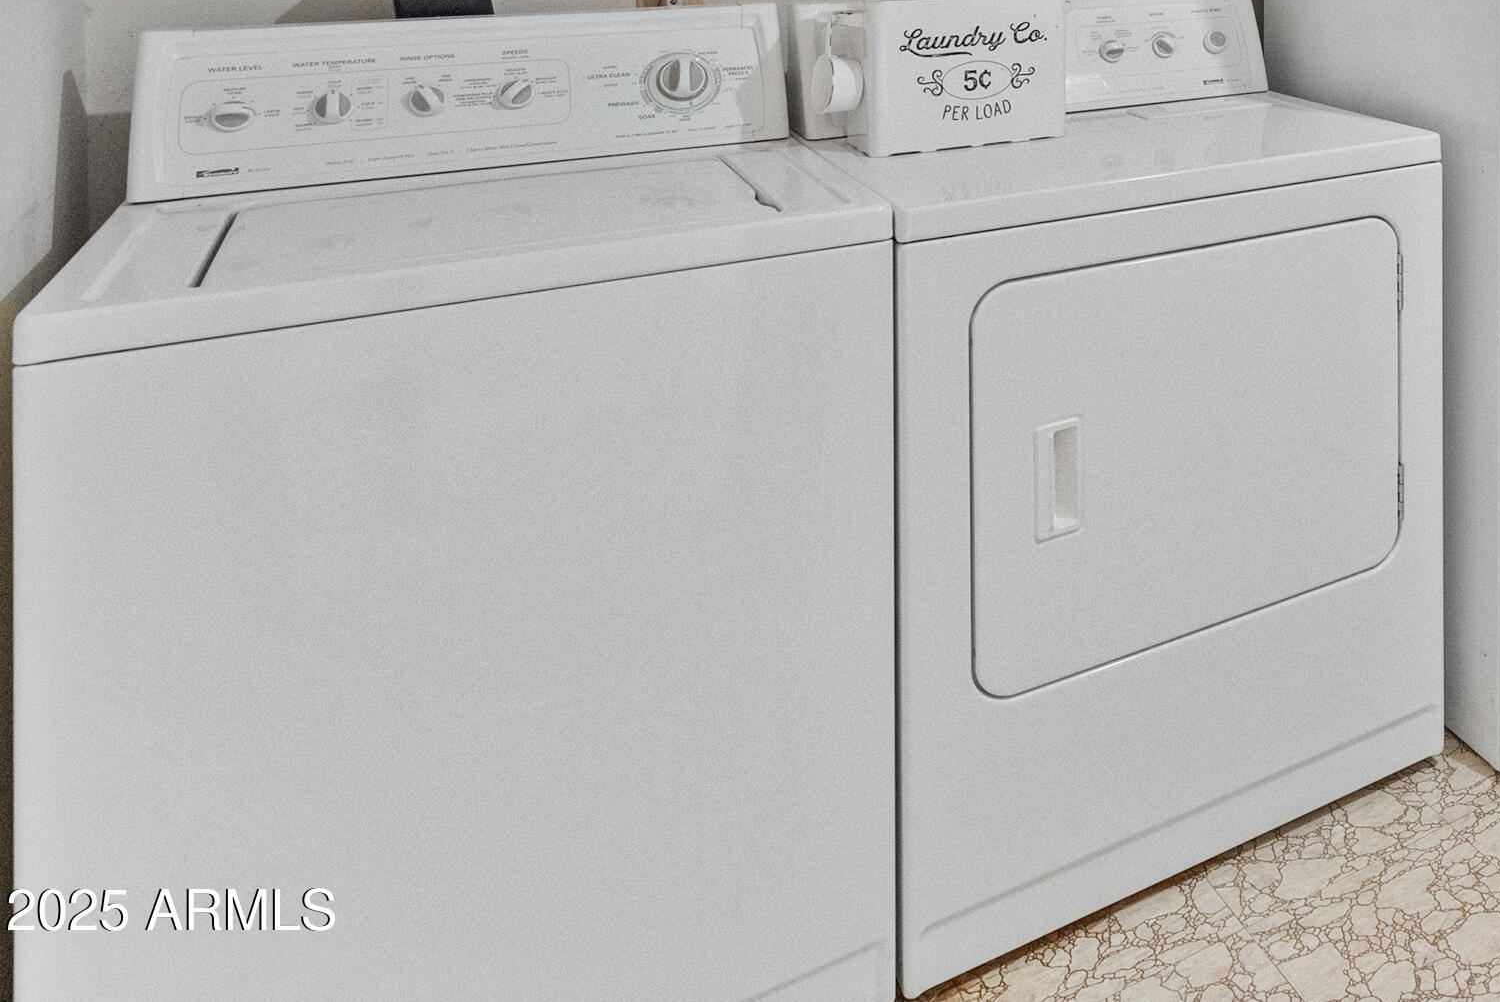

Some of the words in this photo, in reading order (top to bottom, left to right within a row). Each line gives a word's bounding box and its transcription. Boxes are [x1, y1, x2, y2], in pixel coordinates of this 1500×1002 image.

[899, 25, 1006, 56] Laundry
[1009, 21, 1048, 44] Co.
[423, 53, 456, 61] OPTIONS
[207, 66, 237, 74] WATER
[238, 64, 263, 72] LEVEL
[293, 61, 319, 69] WATER
[609, 71, 631, 79] CLEAN
[942, 104, 970, 121] PER
[975, 99, 1012, 120] LOAD
